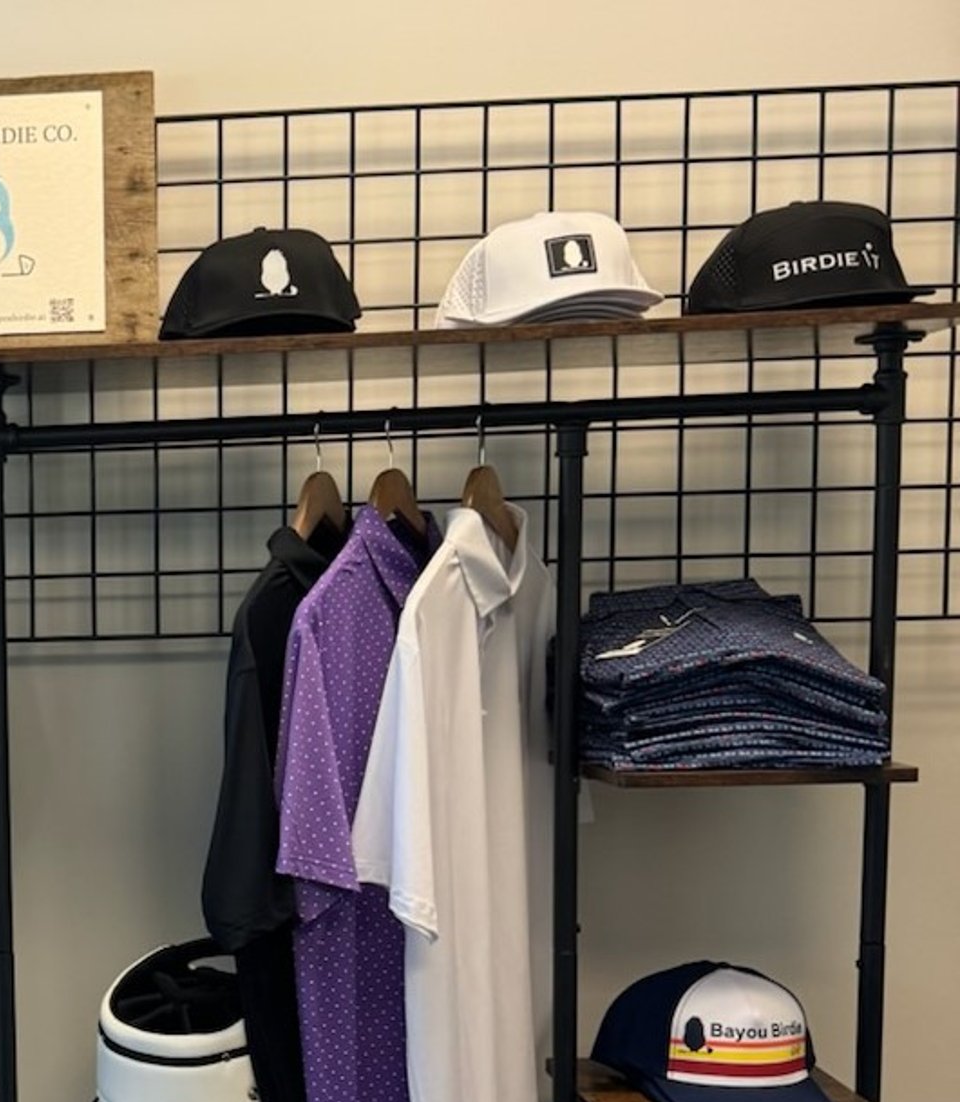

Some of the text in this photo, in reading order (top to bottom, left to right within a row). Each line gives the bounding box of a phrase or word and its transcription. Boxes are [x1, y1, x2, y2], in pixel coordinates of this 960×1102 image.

[43, 124, 78, 143] CO.
[772, 251, 859, 281] BIRDIE
[710, 1023, 768, 1042] Bayou
